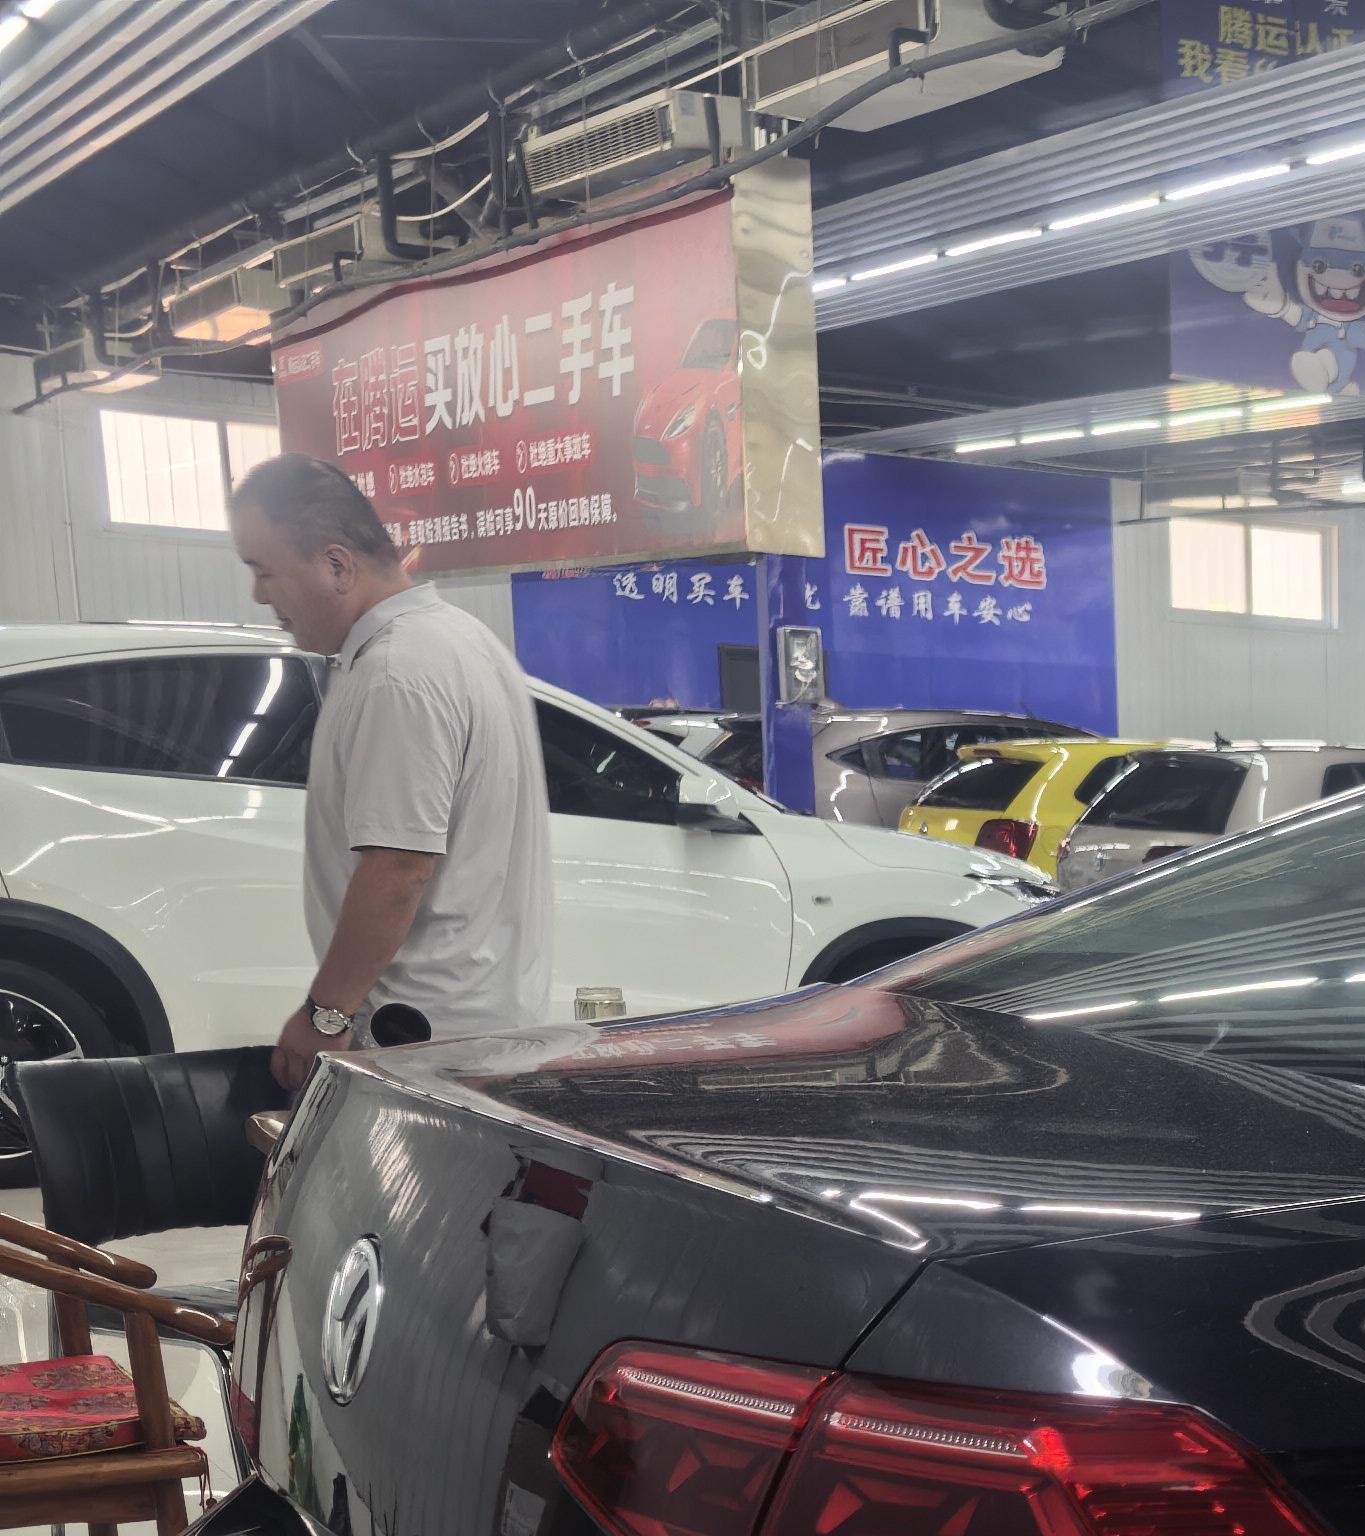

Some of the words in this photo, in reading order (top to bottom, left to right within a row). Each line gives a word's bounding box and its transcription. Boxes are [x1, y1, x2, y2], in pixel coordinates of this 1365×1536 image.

[844, 523, 1047, 590] 匠心之选
[612, 571, 750, 611] 透明买车
[843, 582, 1033, 626] 靠谱用车安心
